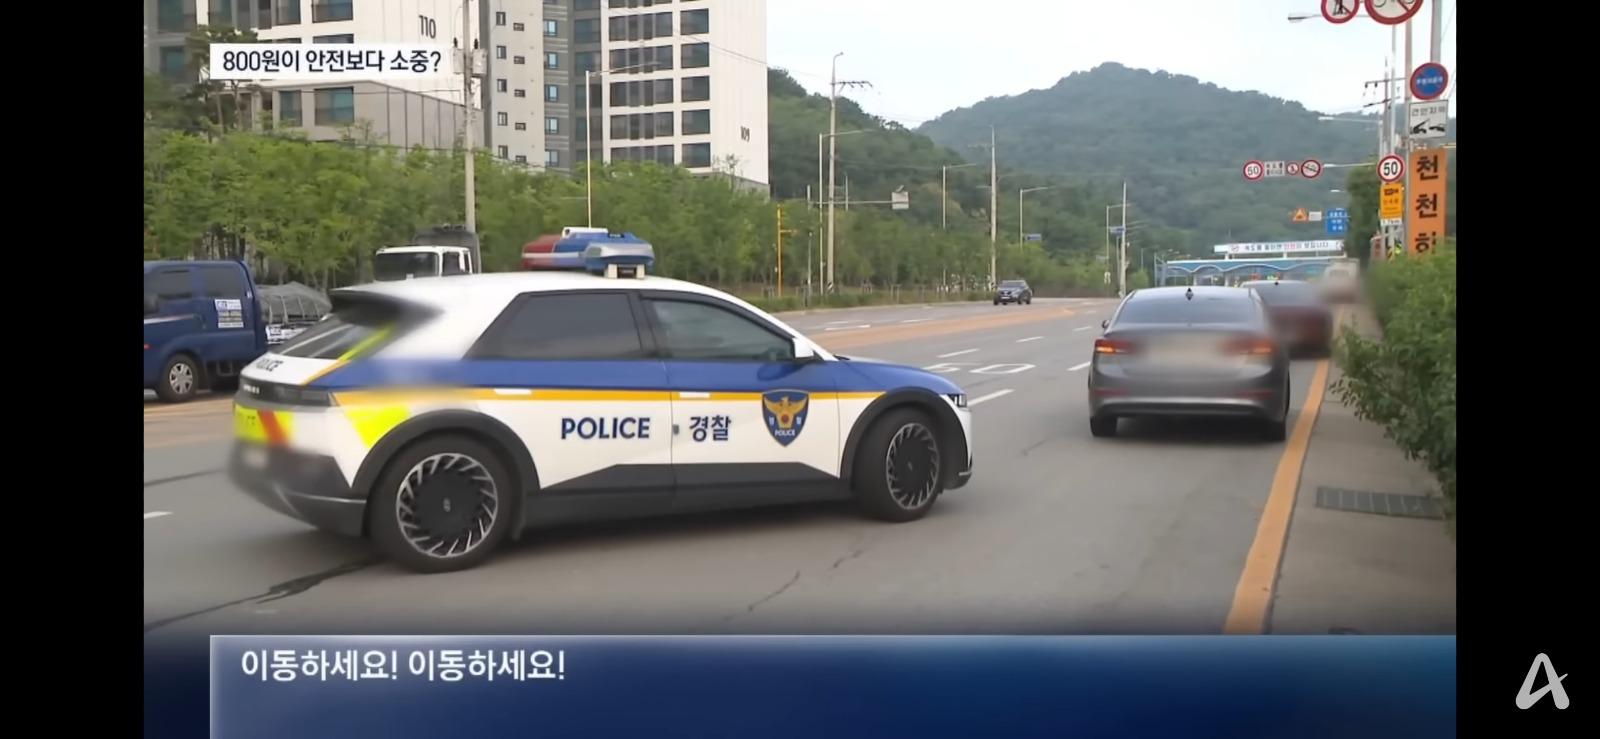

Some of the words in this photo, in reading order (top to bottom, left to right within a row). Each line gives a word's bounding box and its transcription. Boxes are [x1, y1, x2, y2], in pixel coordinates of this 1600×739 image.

[419, 15, 436, 39] 110
[1247, 166, 1259, 176] 50
[1383, 161, 1398, 176] 50
[561, 417, 651, 439] POLICE
[689, 415, 732, 442] 경찰
[774, 429, 796, 437] POLICE
